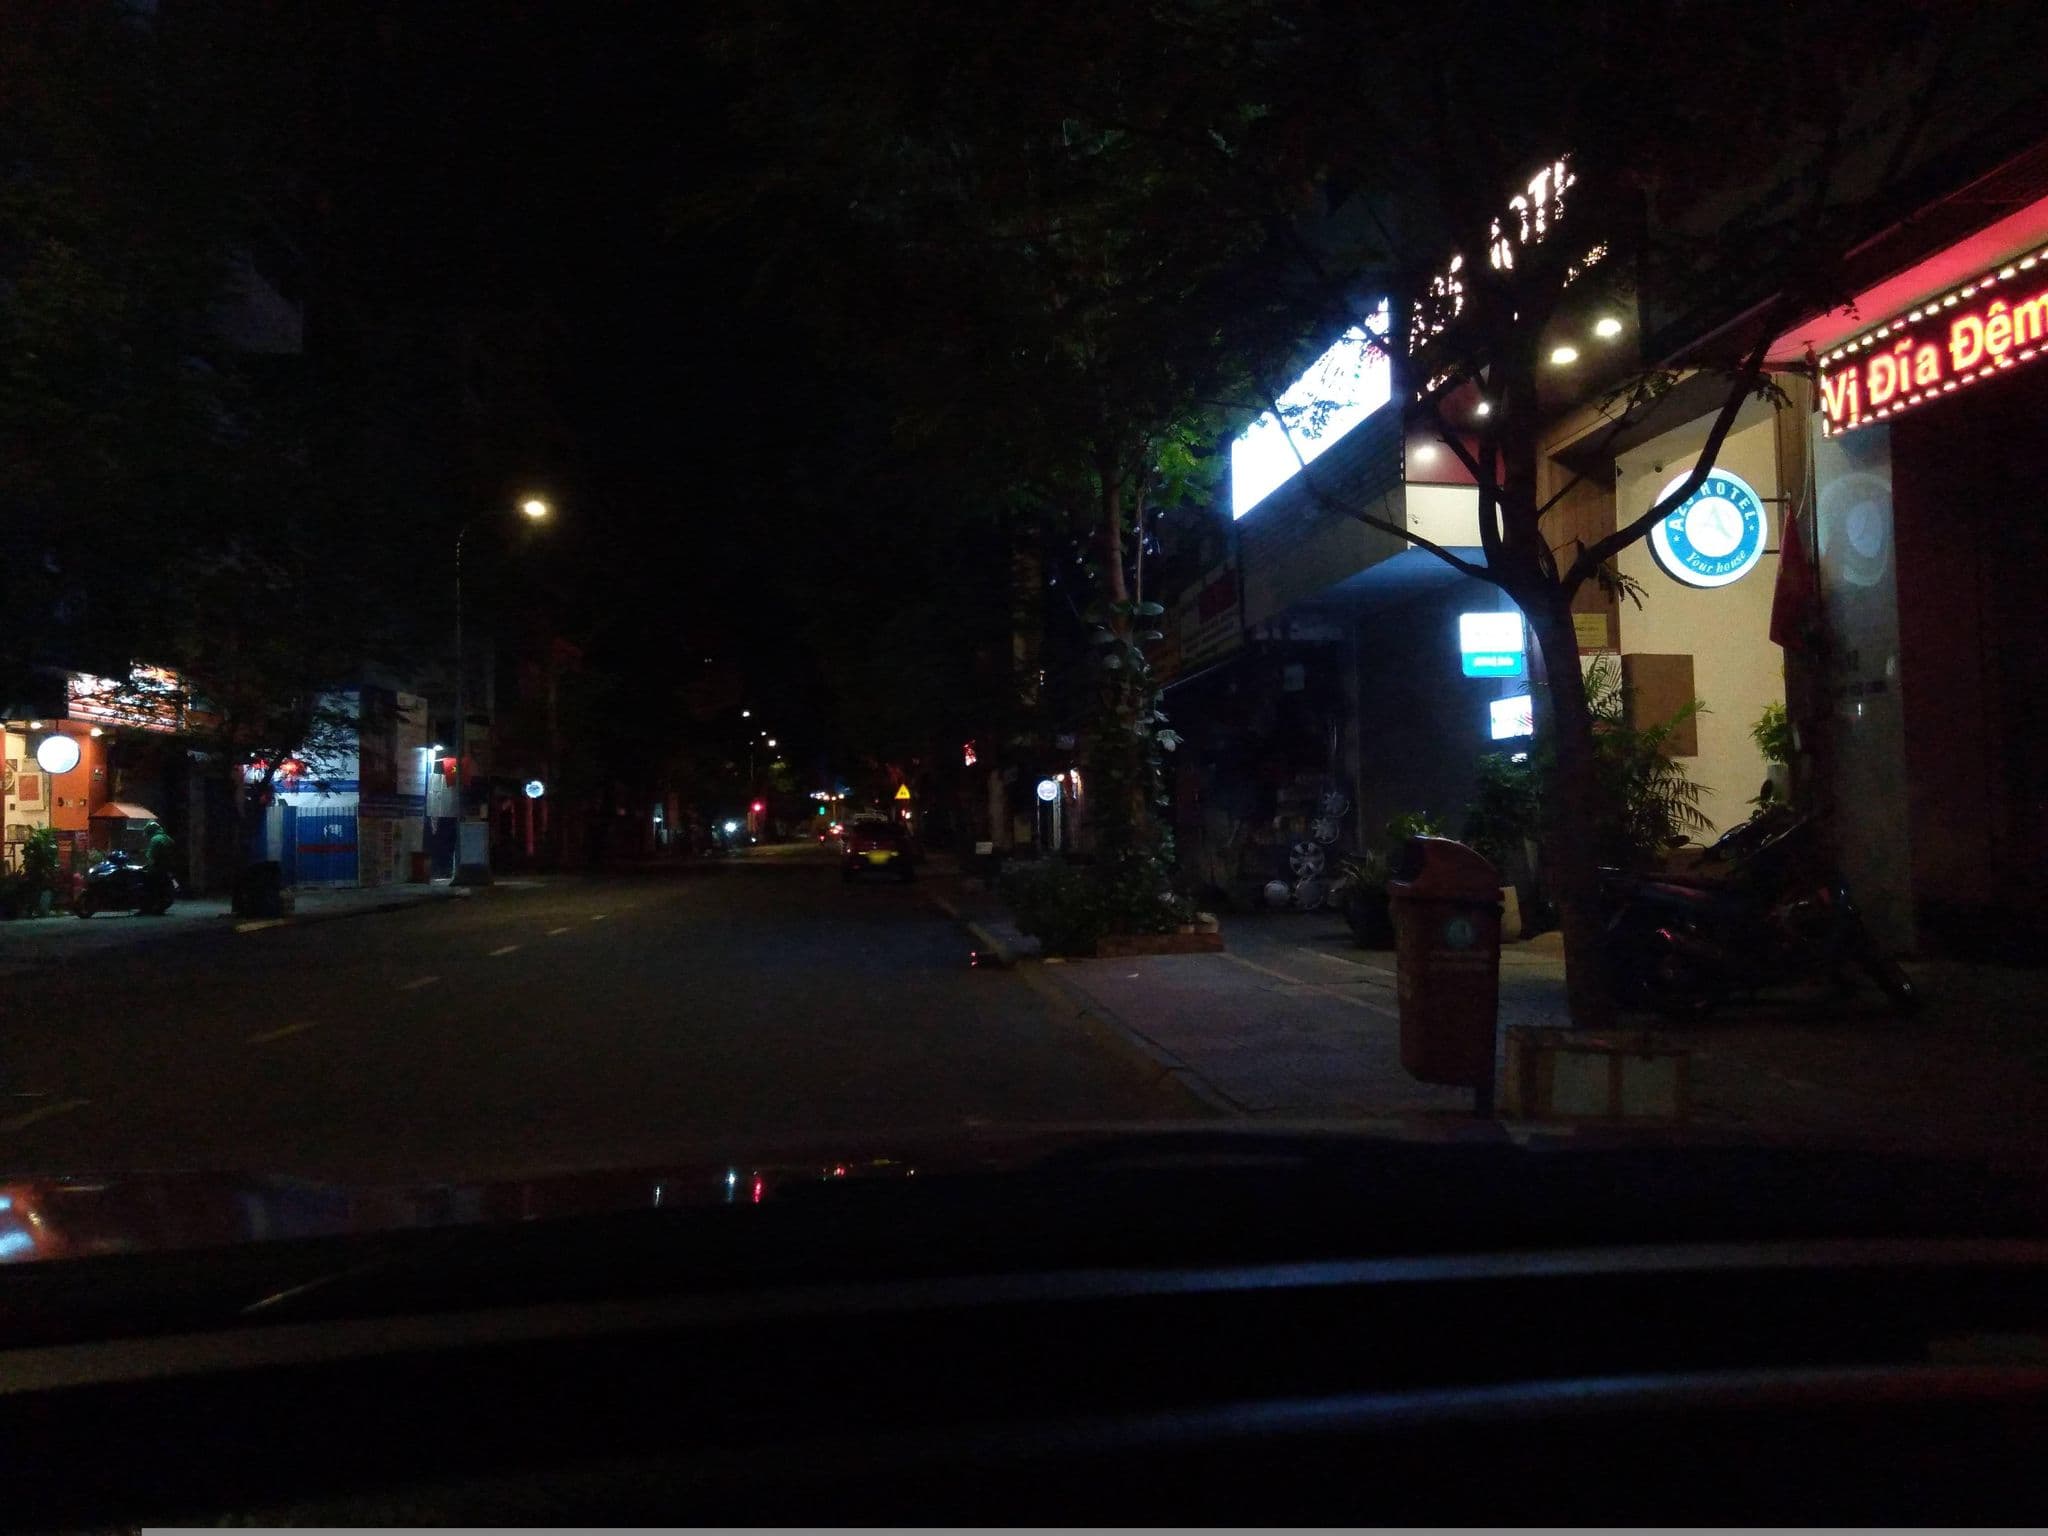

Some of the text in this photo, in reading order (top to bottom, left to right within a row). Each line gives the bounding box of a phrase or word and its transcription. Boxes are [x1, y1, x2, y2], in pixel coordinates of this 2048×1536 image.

[1823, 367, 1859, 424] Vị
[1867, 339, 1940, 406] Đĩa
[1701, 482, 1756, 521] HOTEL
[1686, 549, 1747, 574] Your house
